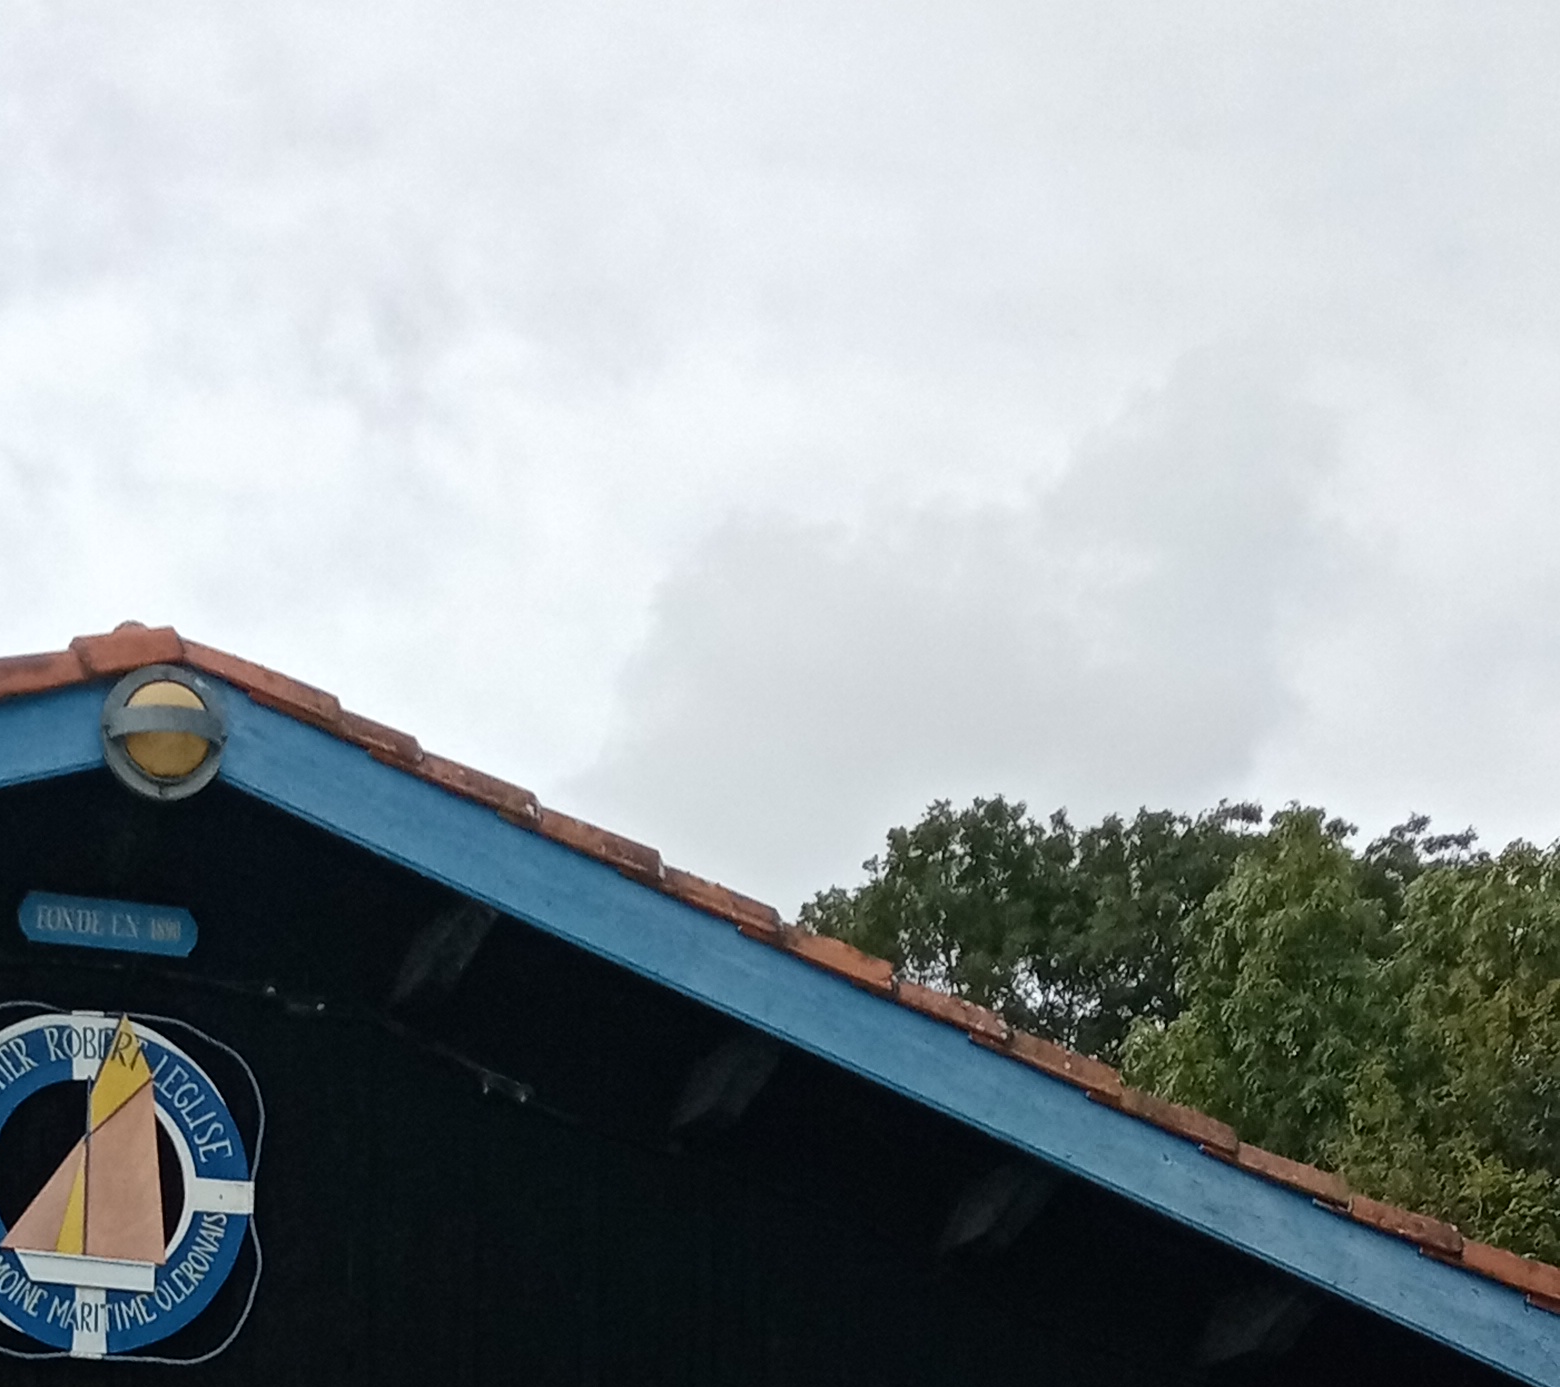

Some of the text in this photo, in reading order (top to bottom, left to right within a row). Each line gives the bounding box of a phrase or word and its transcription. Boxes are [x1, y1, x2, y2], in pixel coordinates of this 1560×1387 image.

[44, 1026, 150, 1071] ROBERT
[48, 1295, 158, 1333] MARITIME
[157, 1211, 228, 1311] OLERONAIS
